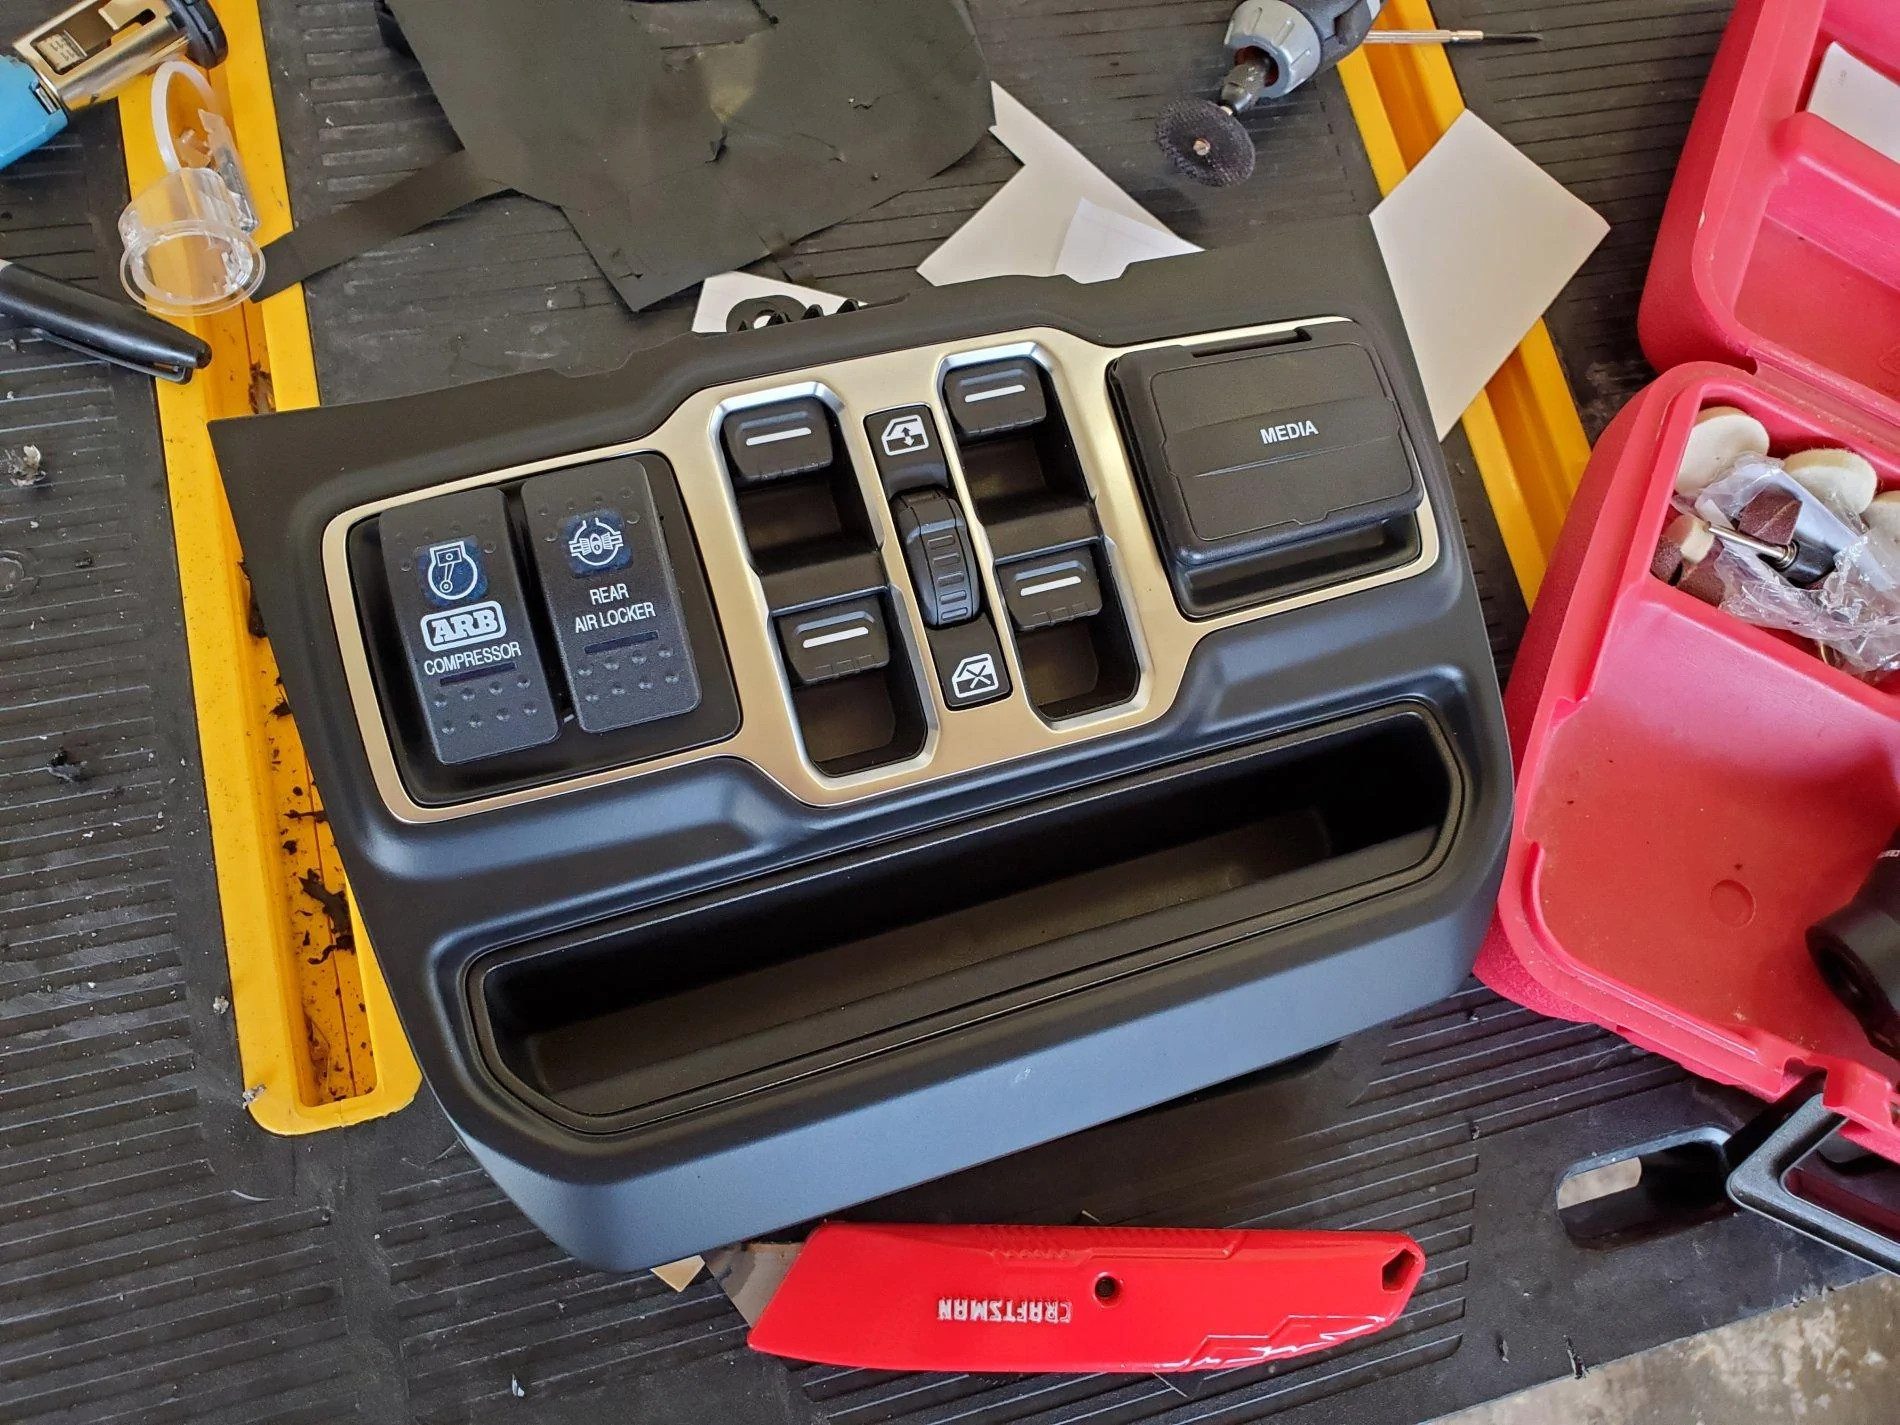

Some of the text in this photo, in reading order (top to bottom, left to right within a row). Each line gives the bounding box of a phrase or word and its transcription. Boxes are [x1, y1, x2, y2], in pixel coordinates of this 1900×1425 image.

[1260, 420, 1319, 444] MEDIA
[589, 583, 630, 605] REAR
[431, 609, 498, 644] ARB
[575, 601, 656, 633] AIR LOCKER
[423, 641, 522, 675] COMPRESSOR
[937, 1298, 1072, 1323] CRAFTSMAN
